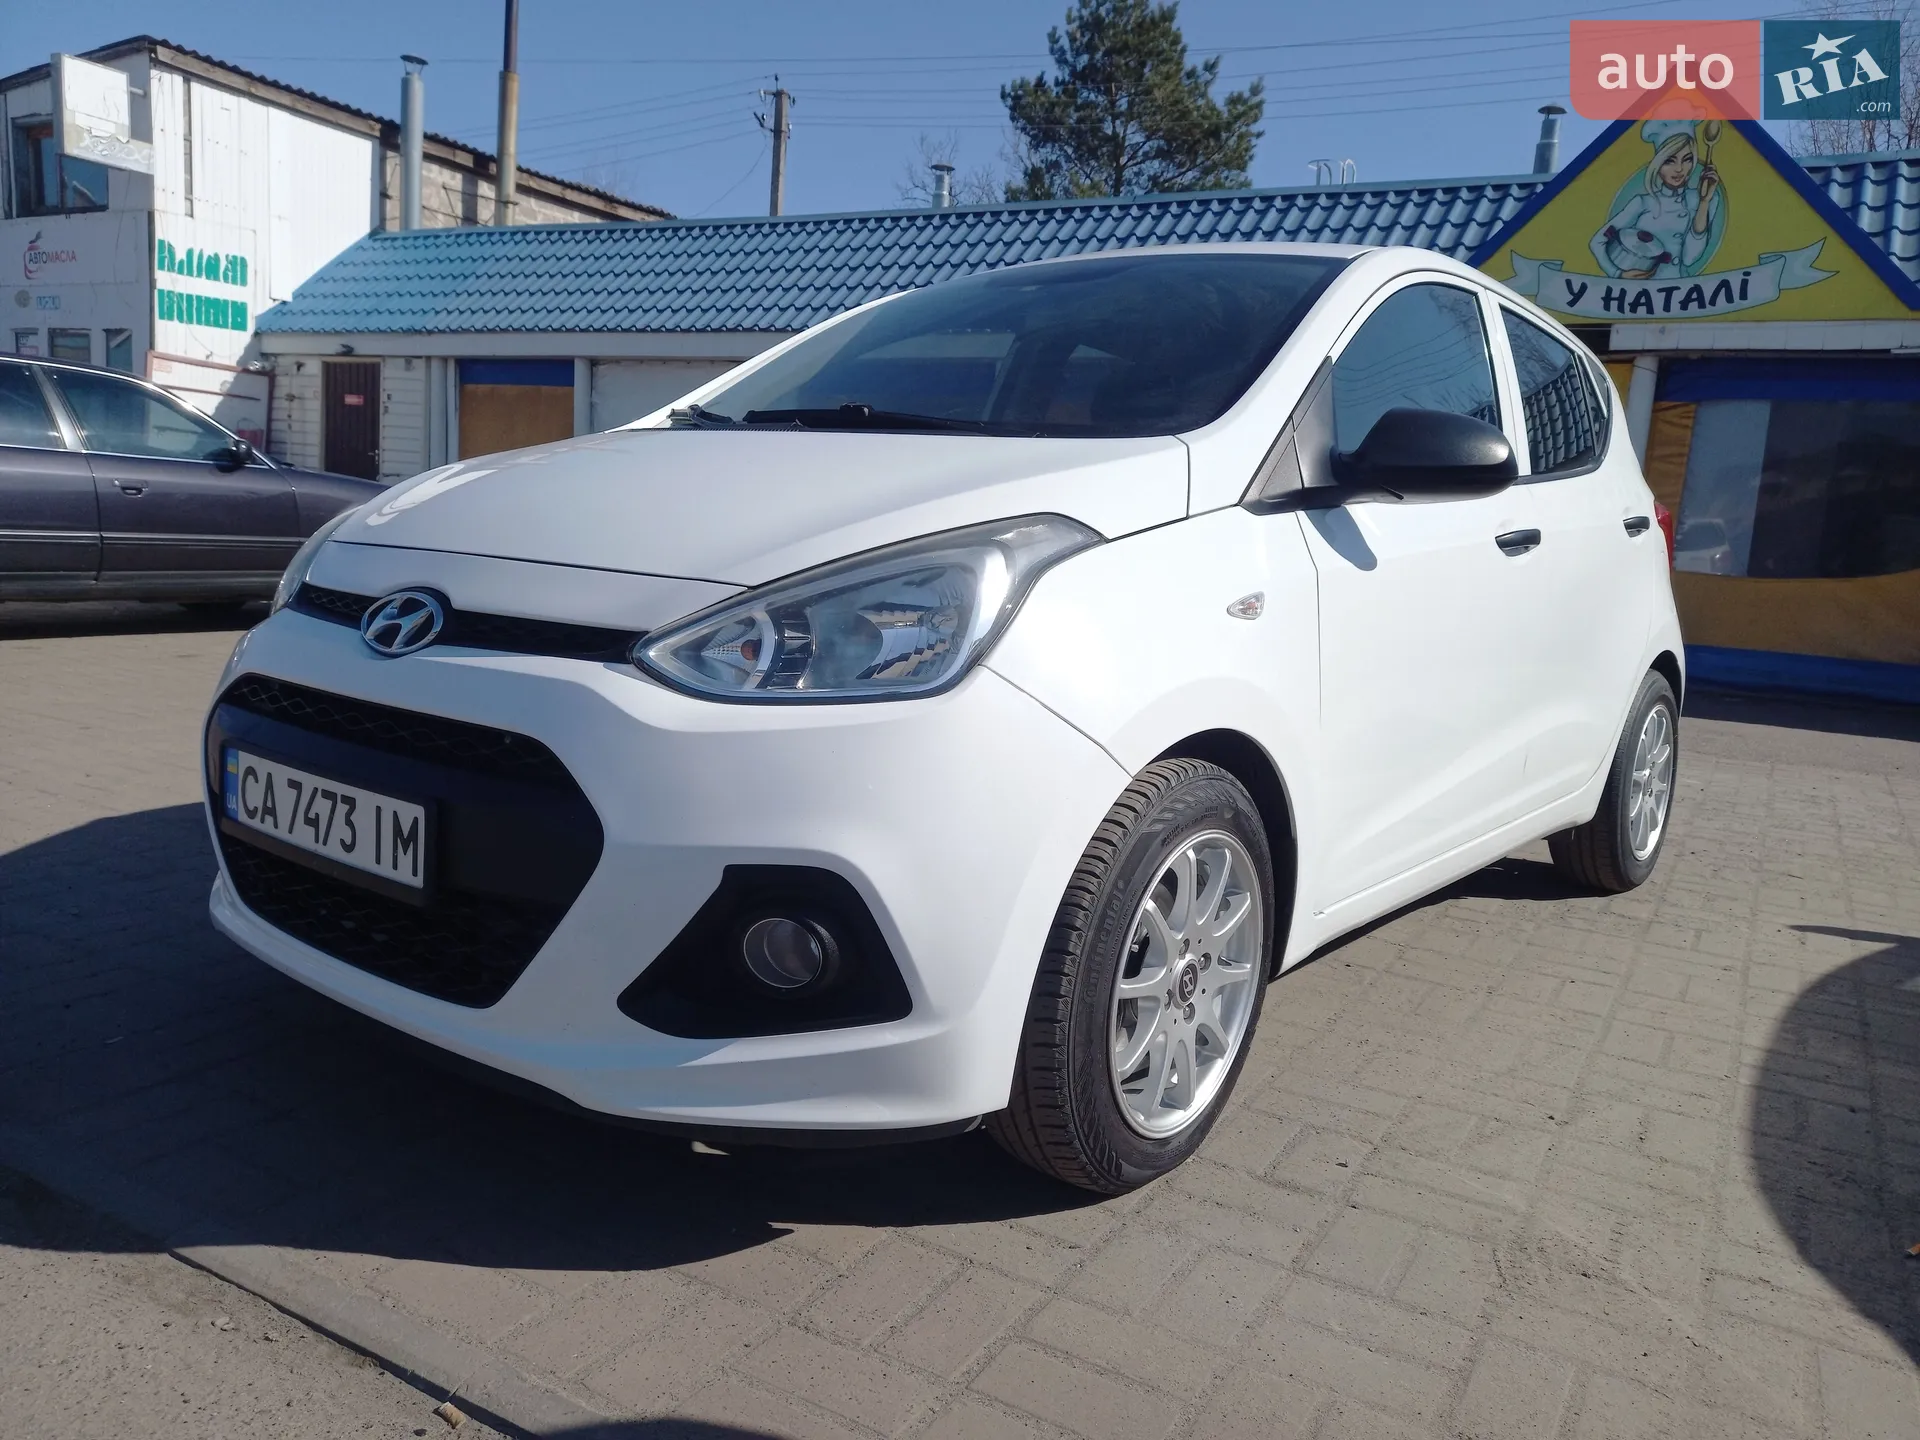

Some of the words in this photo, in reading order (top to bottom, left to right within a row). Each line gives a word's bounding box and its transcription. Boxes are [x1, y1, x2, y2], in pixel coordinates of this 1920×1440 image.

[28, 249, 78, 265] АВТОМАСЛА
[1565, 278, 1589, 308] У
[1600, 271, 1752, 315] НАТАЛІ
[226, 792, 238, 812] UA
[240, 765, 279, 830] CA
[286, 777, 357, 854] 7473
[374, 804, 419, 878] IM
